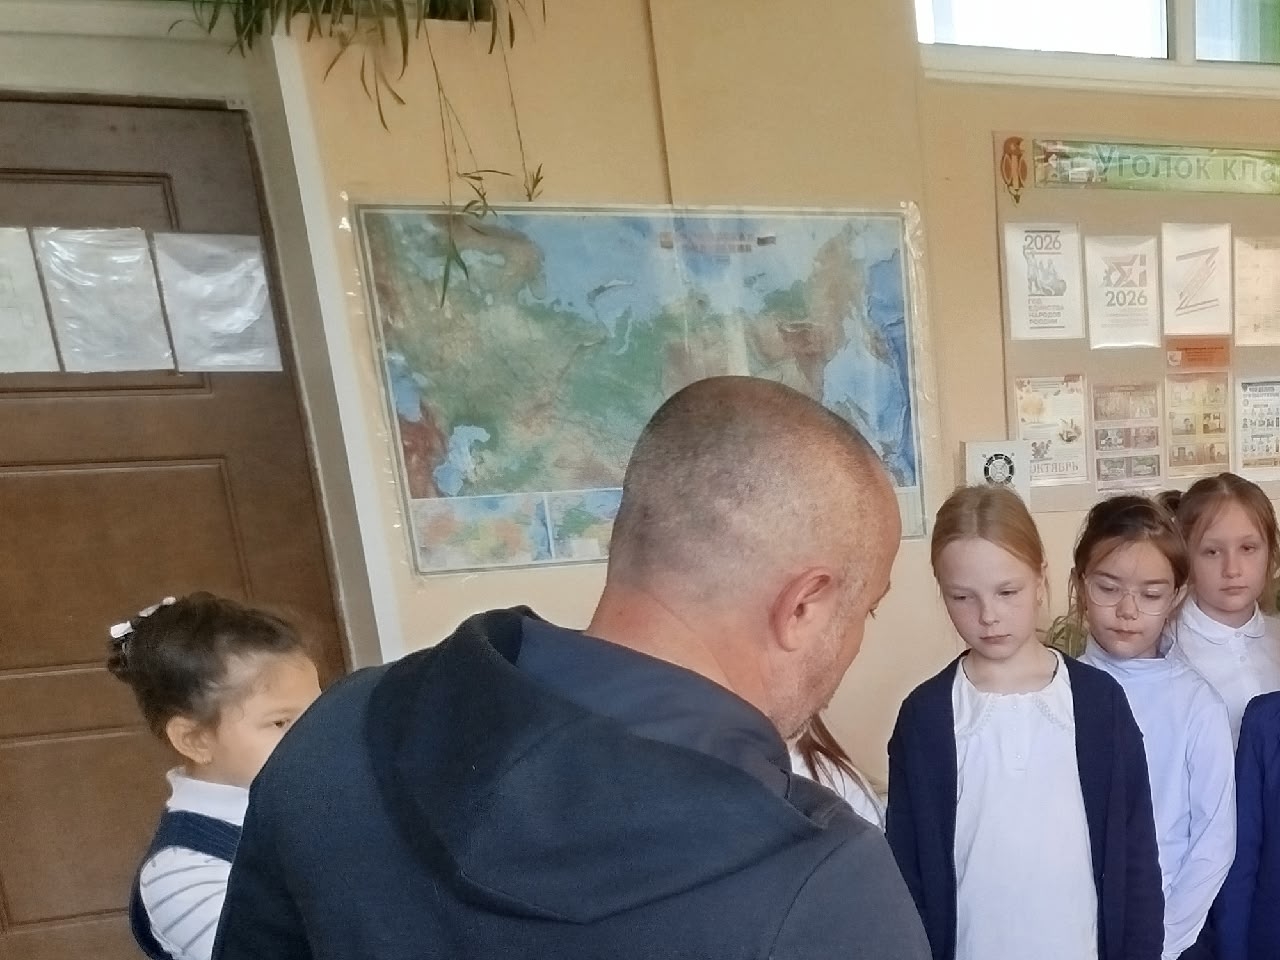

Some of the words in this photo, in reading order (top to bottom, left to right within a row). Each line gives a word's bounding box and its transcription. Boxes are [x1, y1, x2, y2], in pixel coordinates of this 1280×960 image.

[1095, 144, 1210, 180] Уголок
[1024, 234, 1061, 251] 2026
[1105, 290, 1148, 307] 2026
